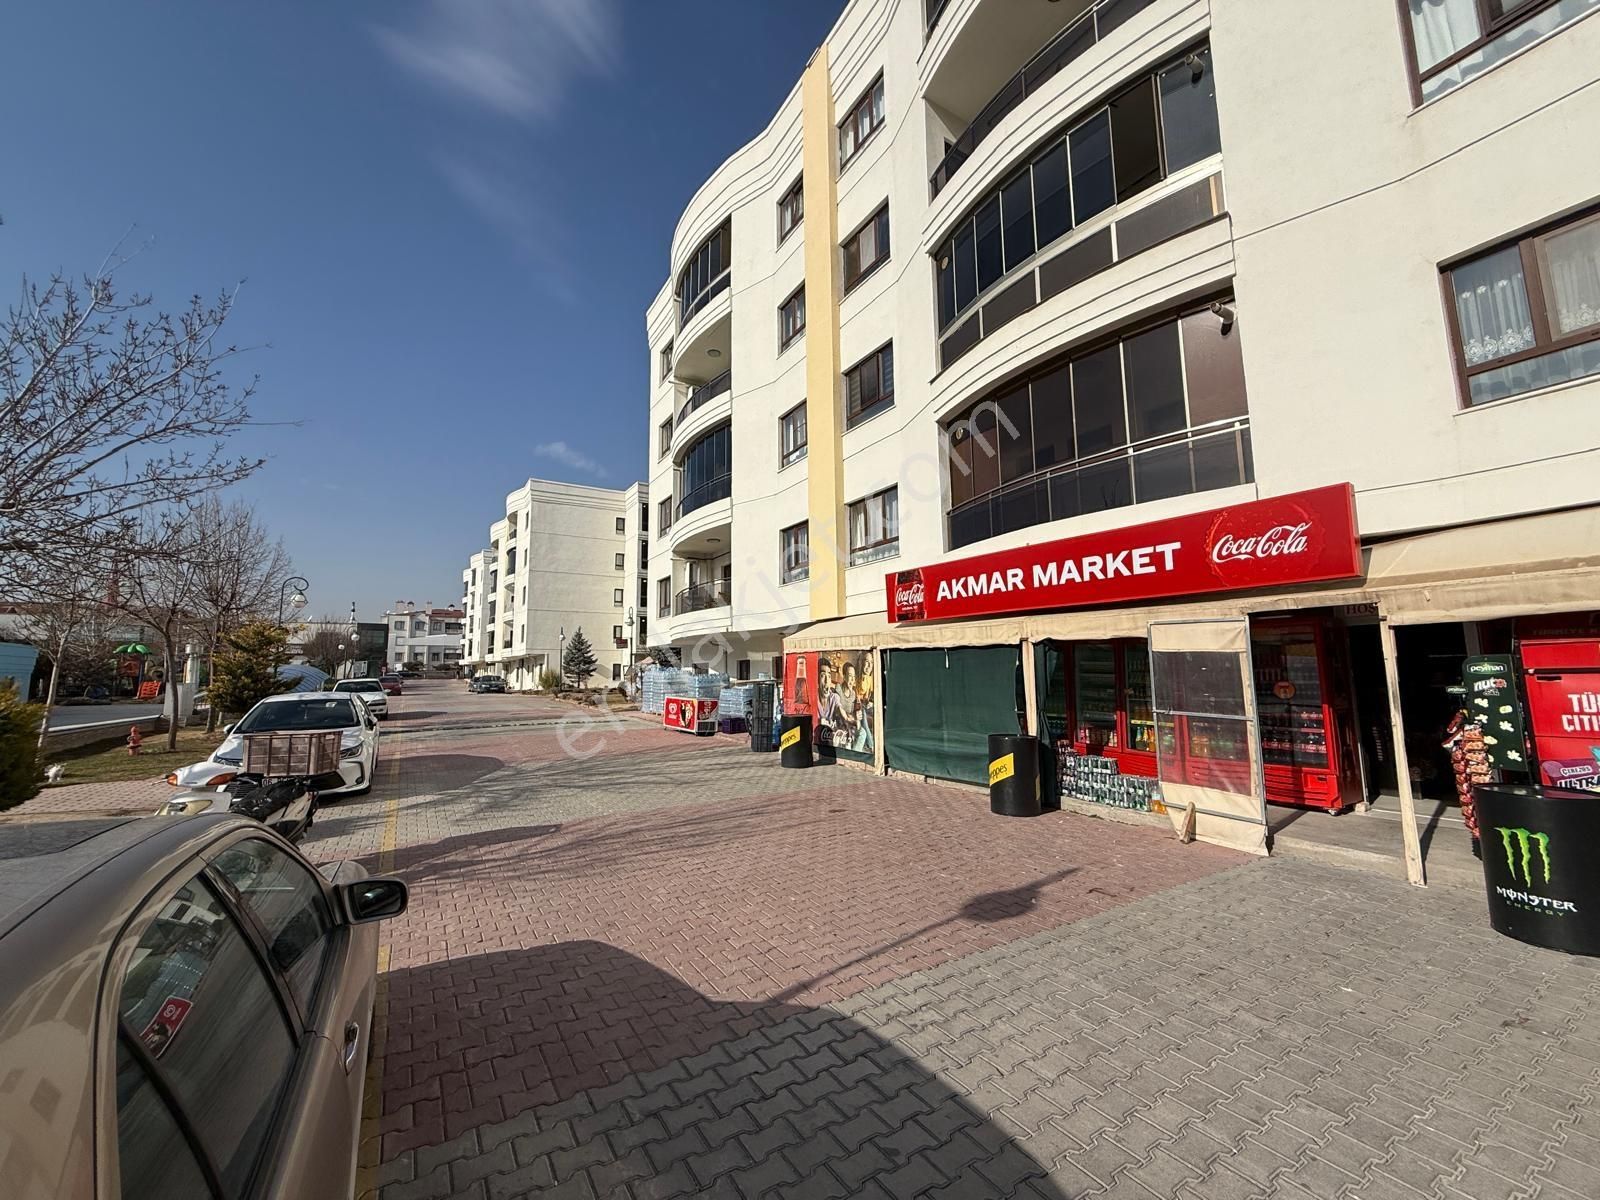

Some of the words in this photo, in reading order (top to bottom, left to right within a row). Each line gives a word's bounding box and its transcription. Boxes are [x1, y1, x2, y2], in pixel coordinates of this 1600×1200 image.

[1212, 521, 1312, 563] Coca-Cola
[936, 568, 1026, 602] AKMAR
[1032, 541, 1182, 588] MARKET
[1567, 691, 1600, 713] TÜ
[1561, 714, 1600, 733] ÇITI
